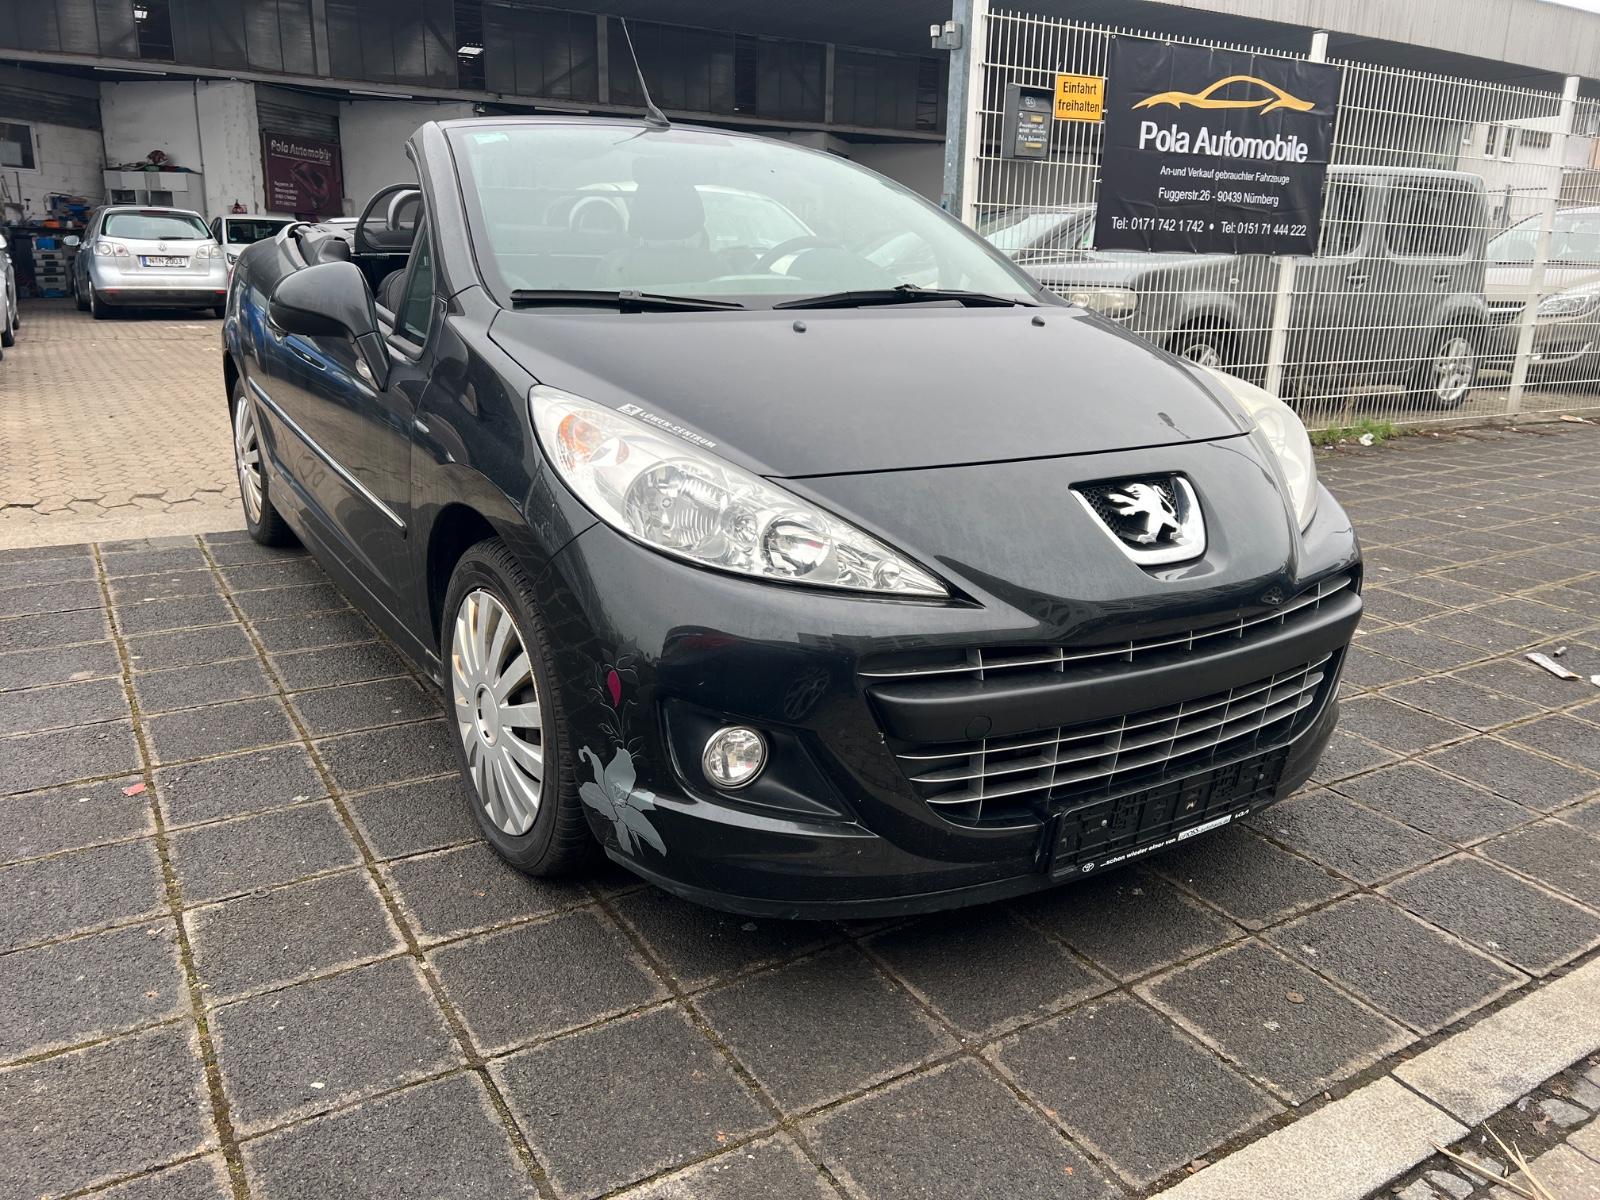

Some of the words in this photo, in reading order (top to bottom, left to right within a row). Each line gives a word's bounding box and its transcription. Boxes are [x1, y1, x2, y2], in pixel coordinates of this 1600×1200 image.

[1063, 81, 1097, 95] Einfahrt
[1058, 99, 1100, 113] freihalten
[271, 139, 288, 153] Pola
[1139, 120, 1190, 154] Pola
[1194, 126, 1308, 163] Automobile
[1160, 165, 1186, 177] An-und
[1188, 167, 1214, 179] Verkauf
[1215, 169, 1254, 183] gebrauchter
[1255, 171, 1290, 184] Fahrzeuge
[1217, 191, 1242, 203] 90439
[1243, 192, 1279, 208] Nürnberg
[1112, 216, 1129, 230] Tel:
[1131, 217, 1155, 231] 0171
[1158, 218, 1176, 232] 742
[1185, 220, 1204, 233] 742
[1221, 221, 1237, 234] Tel:
[1237, 222, 1259, 234] 0151
[1261, 222, 1271, 235] 71
[1273, 223, 1290, 236] 444
[1291, 224, 1307, 237] 222
[1126, 847, 1148, 859] wieder
[1148, 841, 1165, 851] einer
[1165, 837, 1177, 845] von
